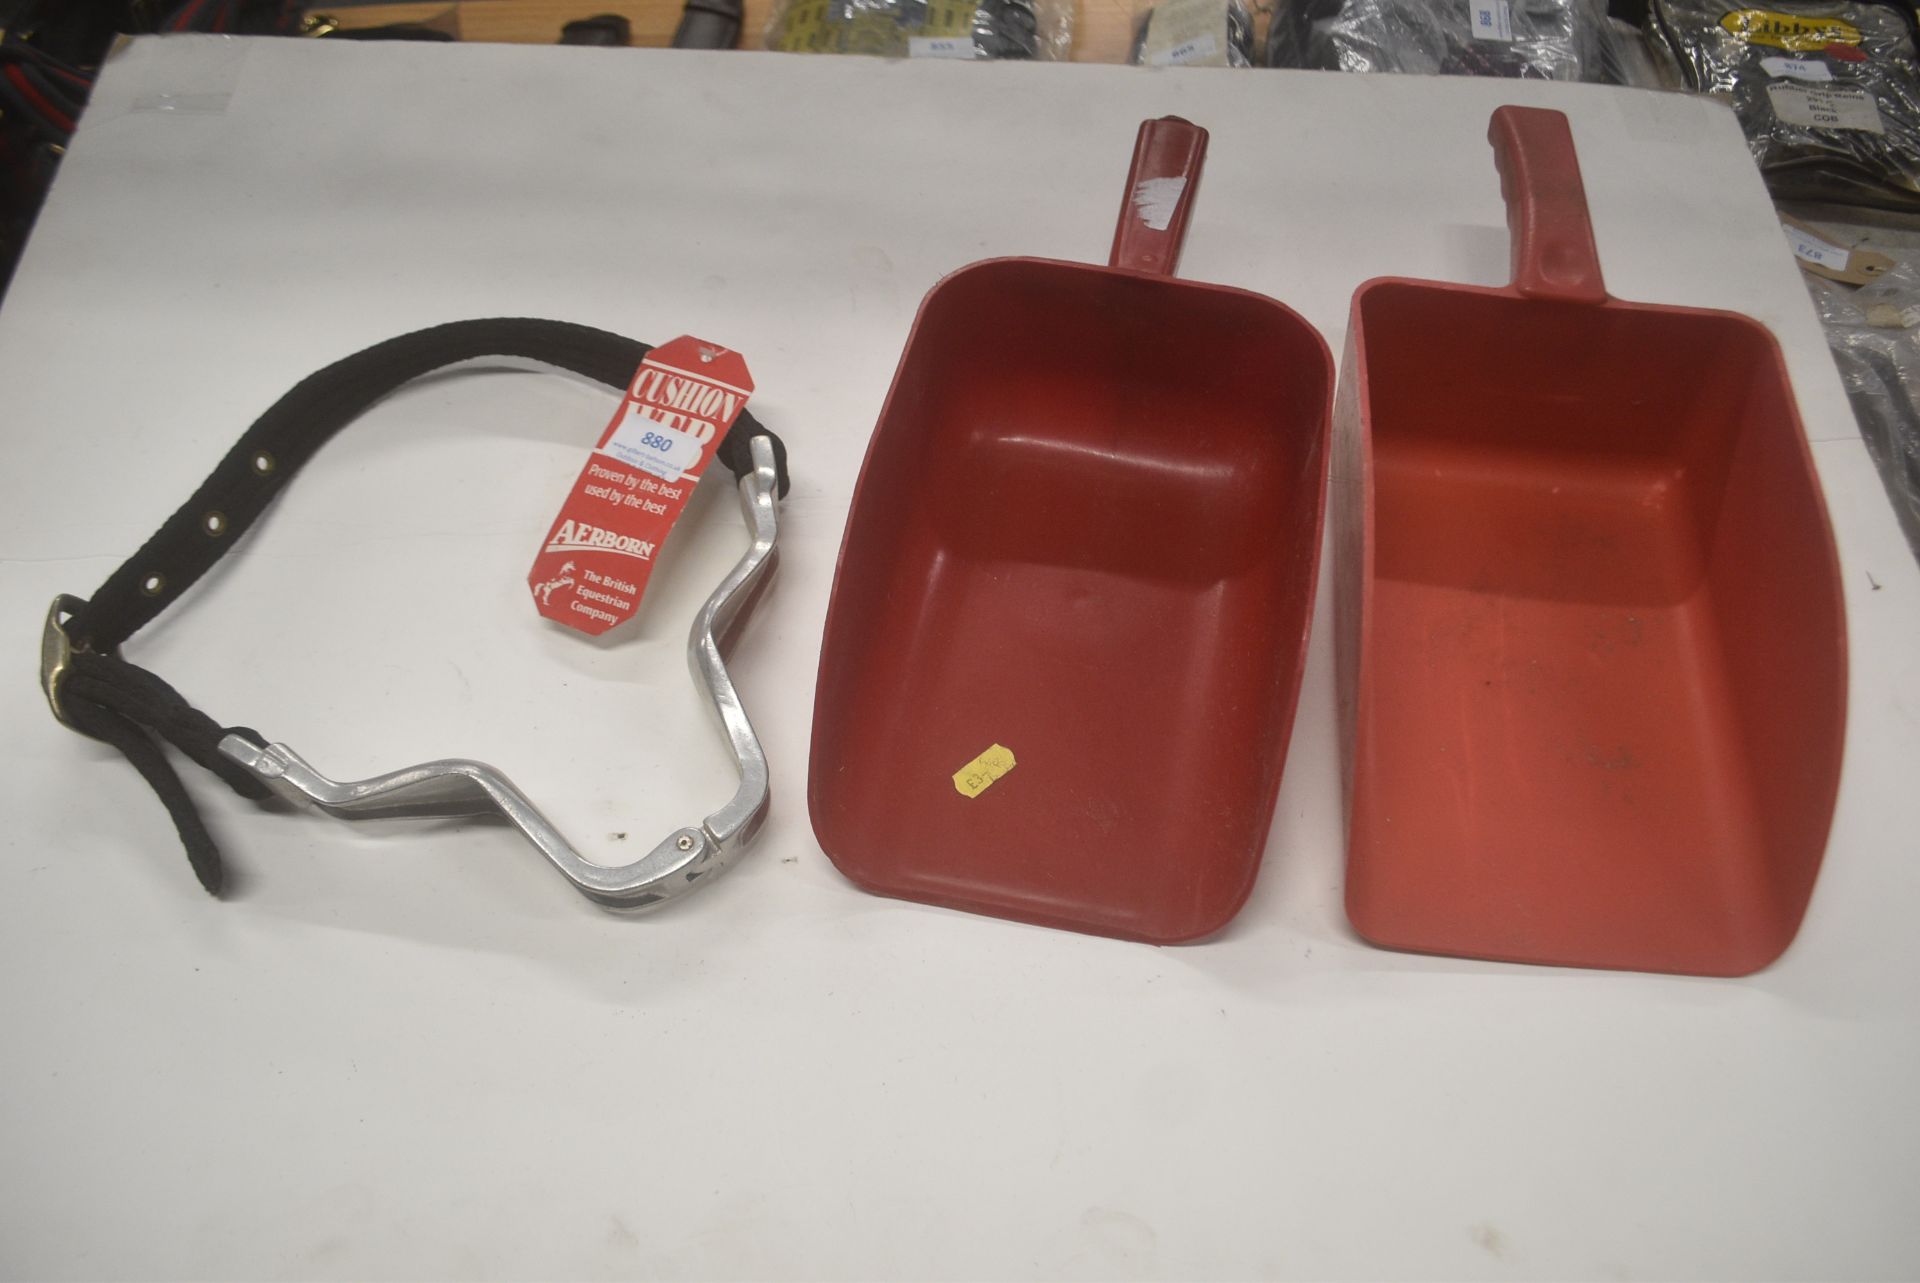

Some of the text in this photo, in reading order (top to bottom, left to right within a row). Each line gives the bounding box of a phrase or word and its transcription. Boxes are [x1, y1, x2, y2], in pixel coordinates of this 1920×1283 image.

[631, 368, 745, 423] CUSHION
[641, 431, 673, 452] 880
[588, 463, 683, 500] Proven by the best
[584, 484, 667, 515] used by the best
[549, 518, 656, 557] AERBORN
[583, 569, 637, 595] The British
[576, 585, 631, 611] Equestrian
[570, 600, 618, 626] Company
